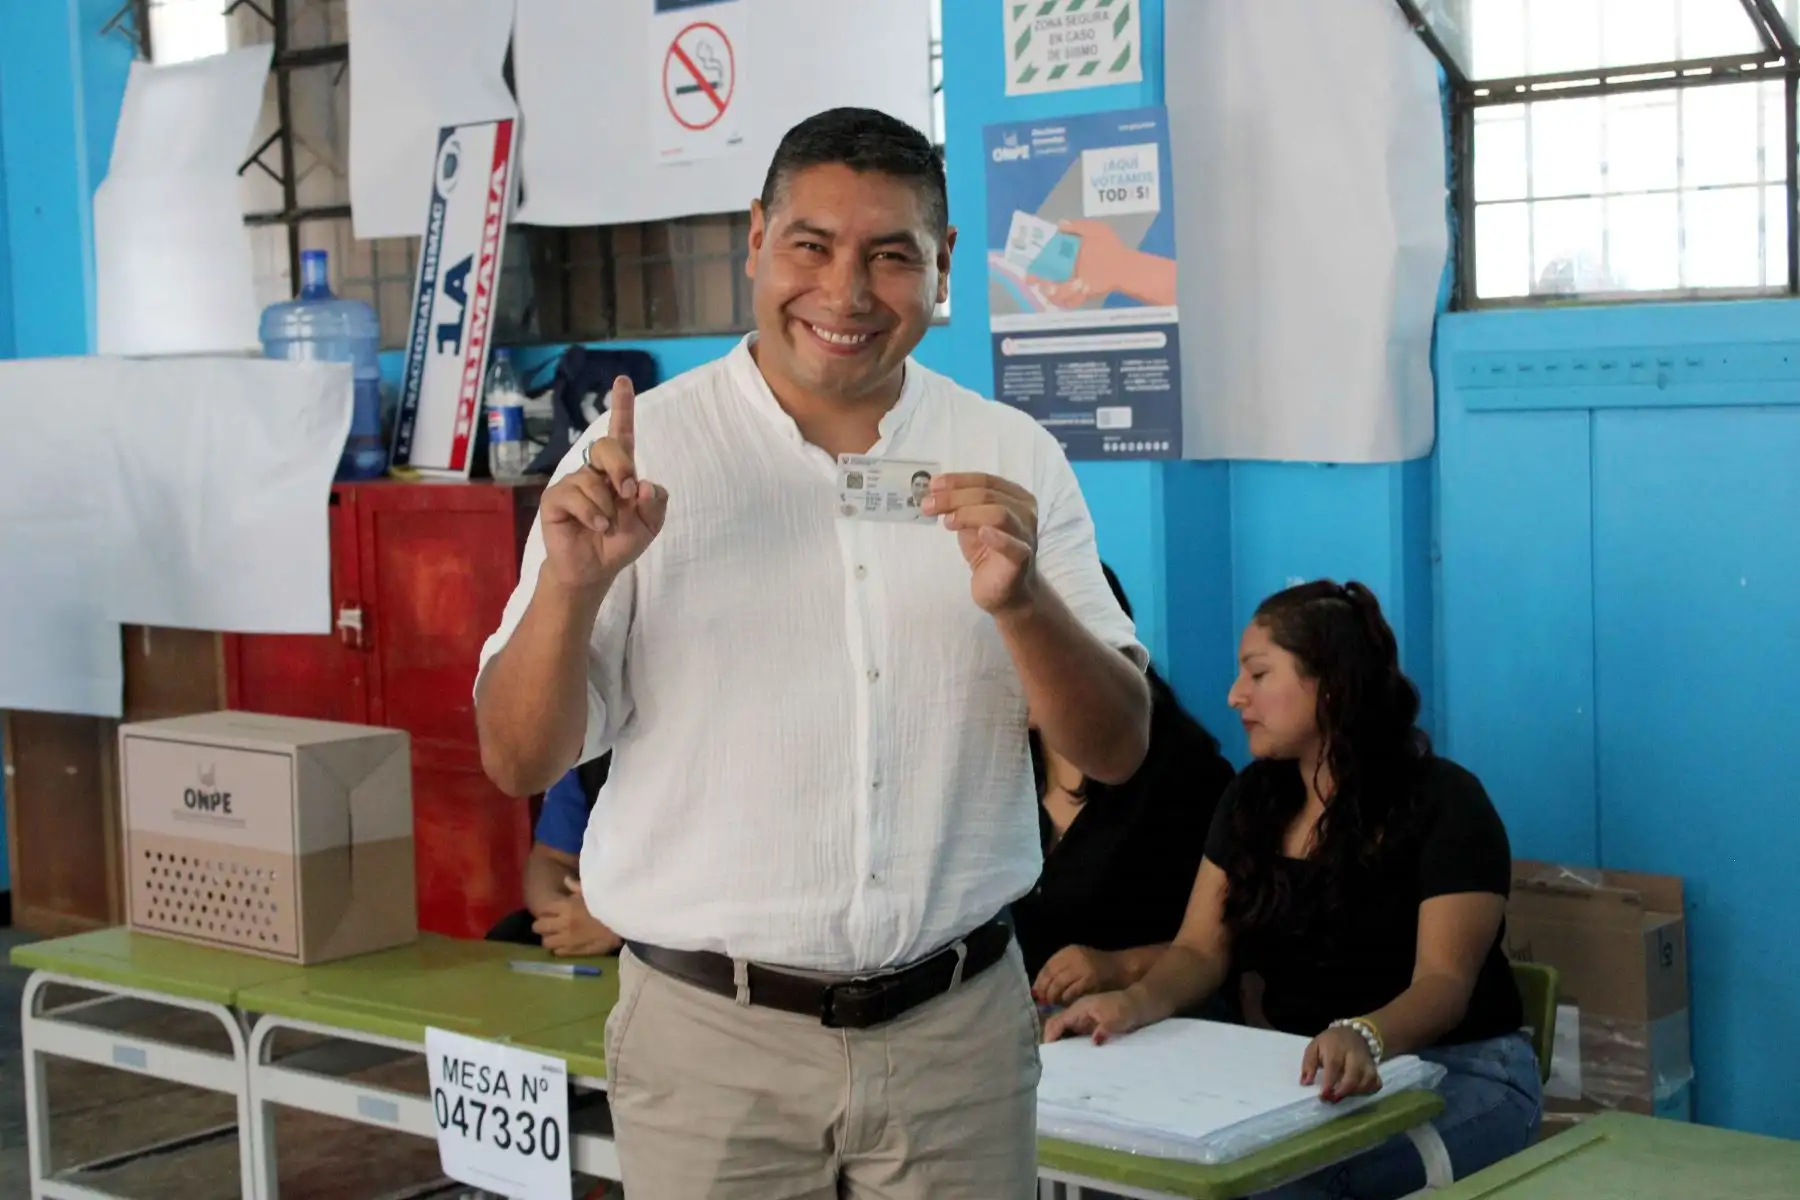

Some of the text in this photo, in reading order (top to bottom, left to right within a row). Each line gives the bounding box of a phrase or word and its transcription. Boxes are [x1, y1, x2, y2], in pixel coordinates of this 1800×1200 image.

[1049, 28, 1096, 47] EN CASO
[1065, 10, 1110, 28] SEGURA
[405, 288, 433, 408] NACIONAL
[424, 202, 444, 282] RIMAC
[456, 160, 508, 438] PRIMARIA
[184, 787, 232, 815] ONPE
[442, 1054, 511, 1099] MESA
[434, 1087, 560, 1161] 047330
